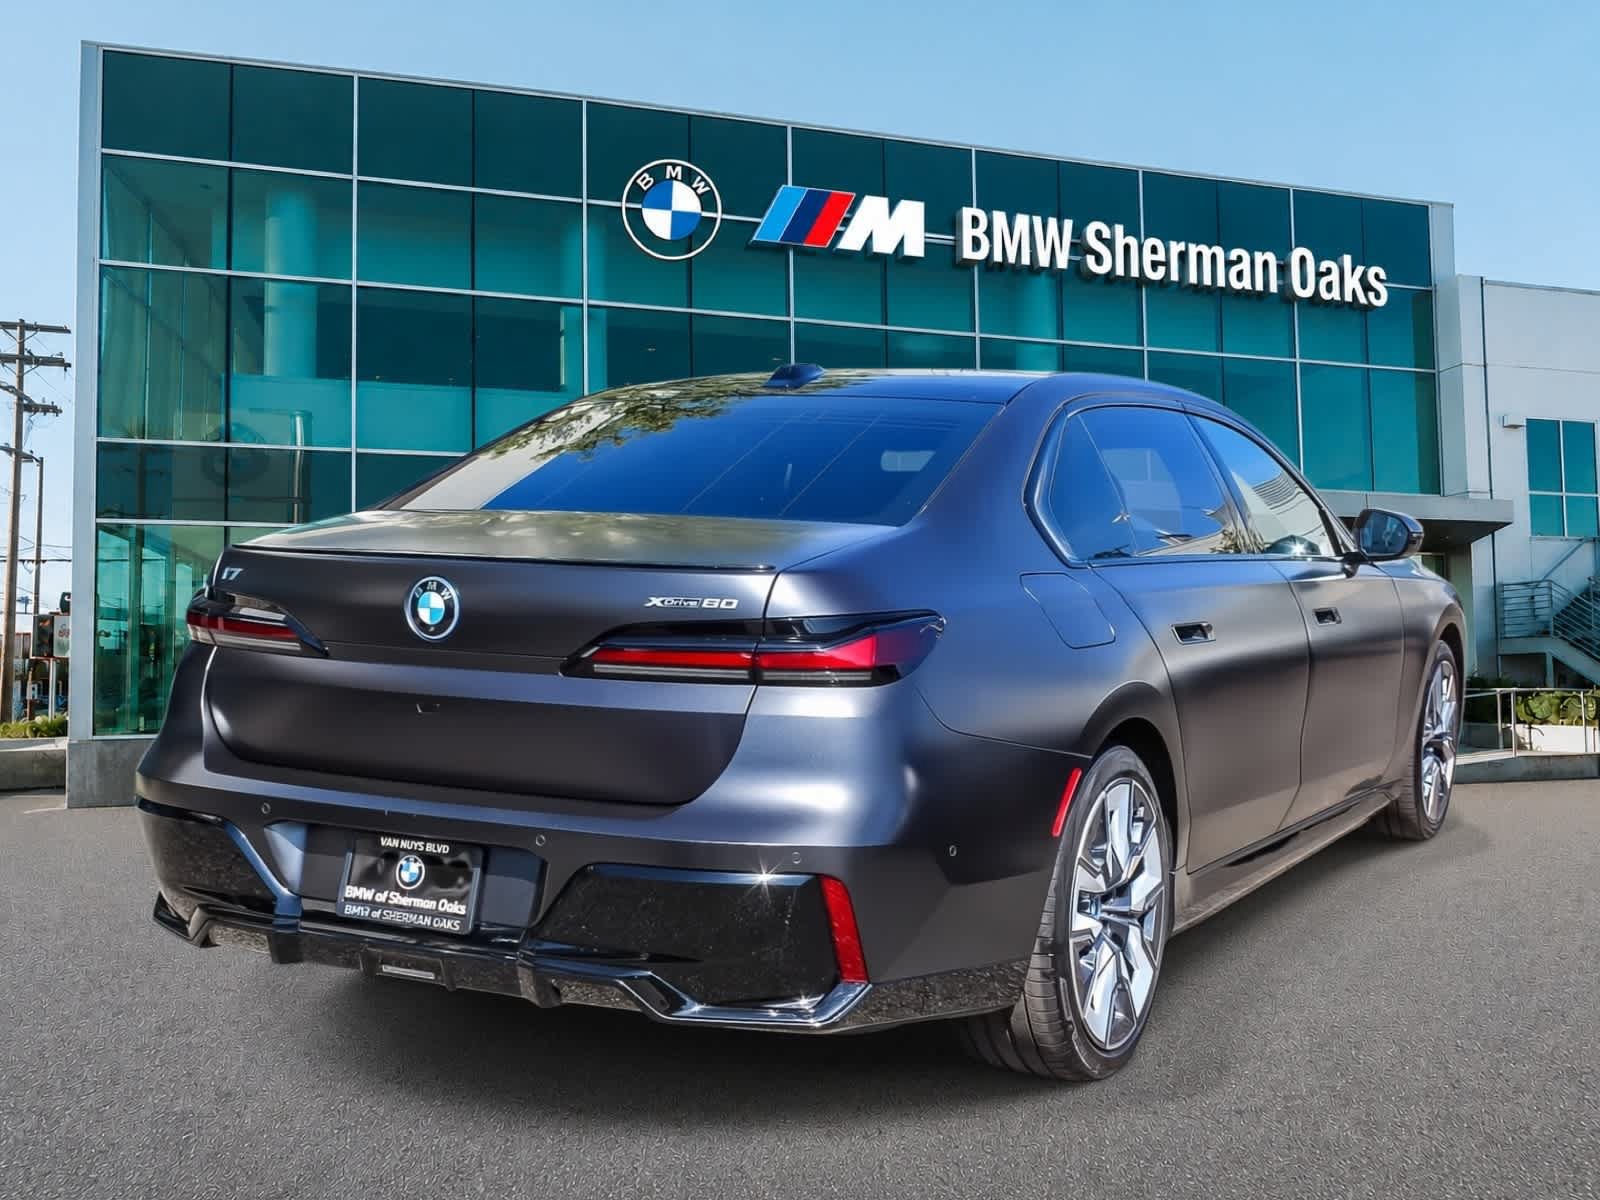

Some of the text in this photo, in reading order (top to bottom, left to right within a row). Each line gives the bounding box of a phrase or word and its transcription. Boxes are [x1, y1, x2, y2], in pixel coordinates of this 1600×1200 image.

[636, 165, 711, 195] BMW
[960, 206, 1388, 308] BMW Sherman Oaks
[414, 581, 452, 600] BMW
[380, 836, 450, 854] VAN NUYS BLVD
[344, 885, 467, 915] BMW of Sherman Oaks
[371, 909, 382, 919] of
[382, 910, 432, 927] SHERMAN
[432, 917, 461, 931] OAKS
